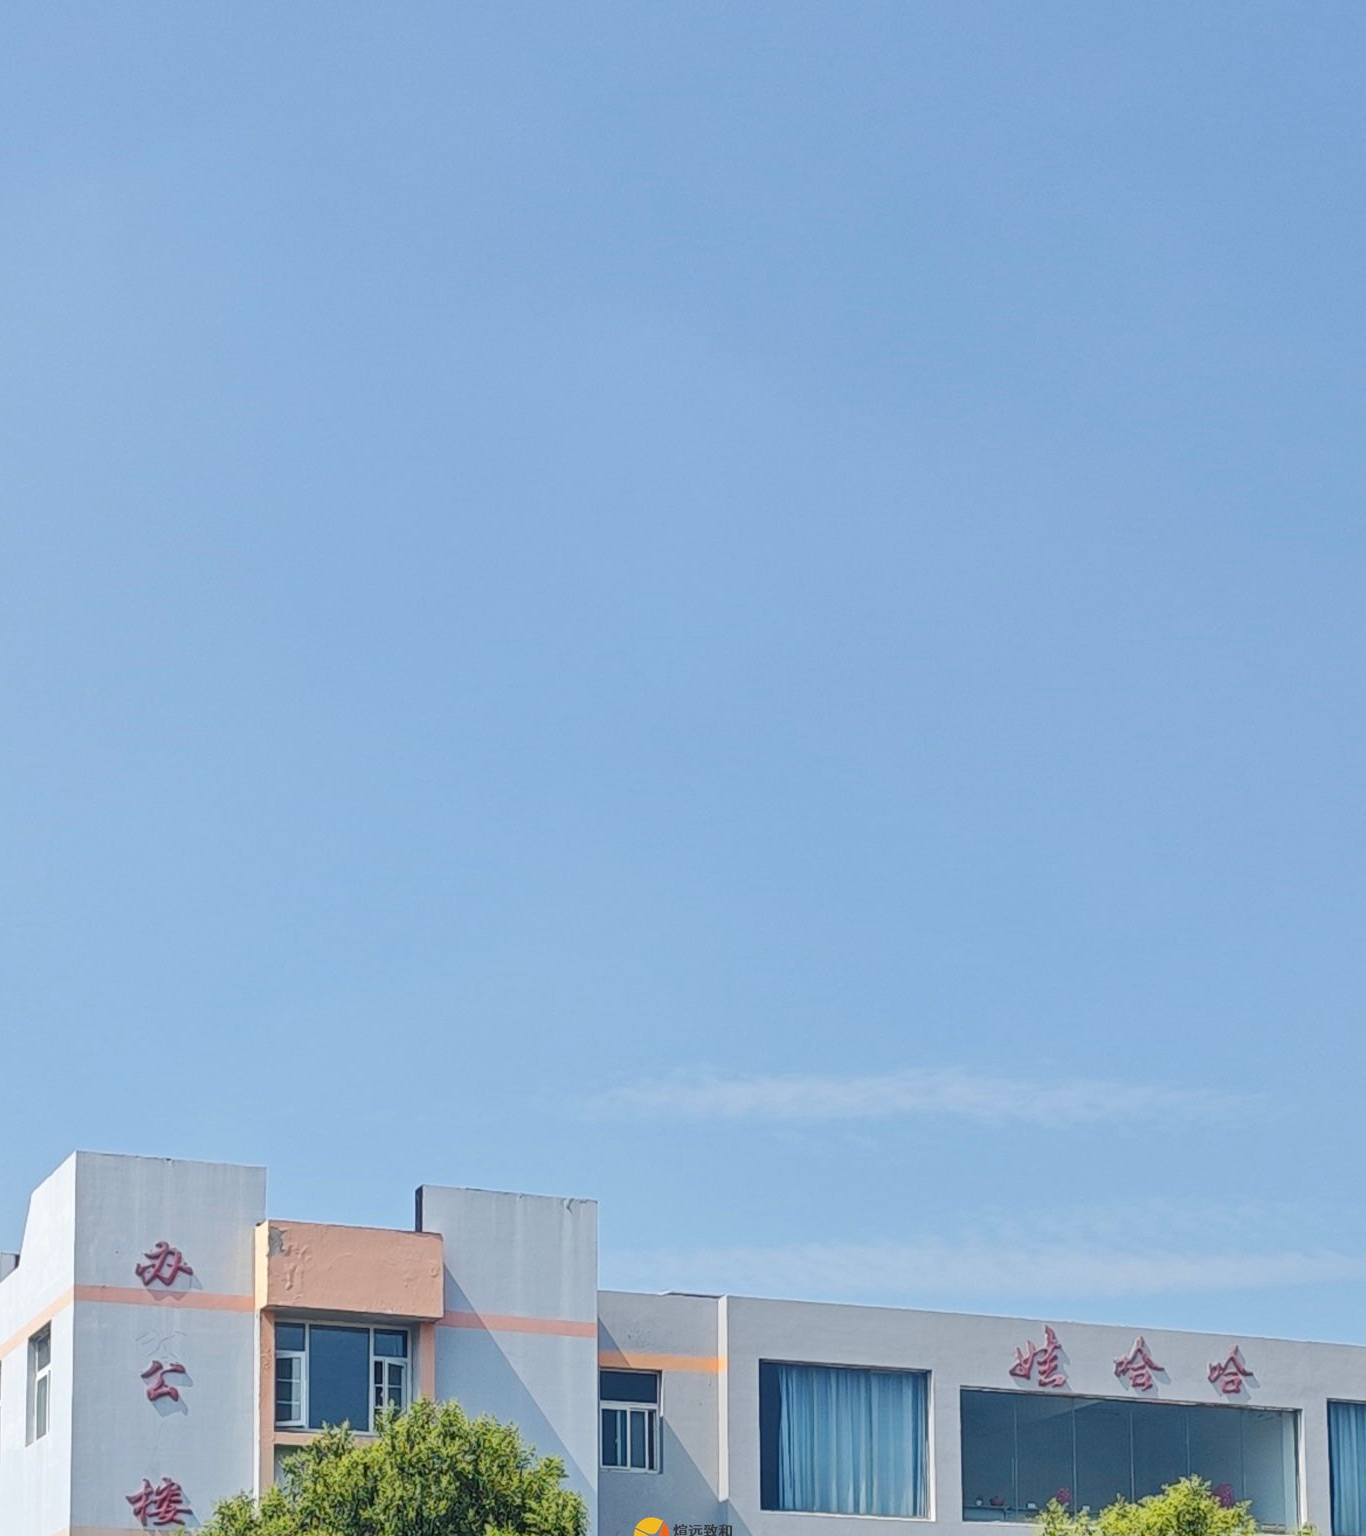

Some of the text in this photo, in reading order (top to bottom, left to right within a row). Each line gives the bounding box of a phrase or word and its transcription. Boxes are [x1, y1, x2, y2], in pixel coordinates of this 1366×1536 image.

[126, 1240, 193, 1527] 办公楼
[1009, 1325, 1253, 1394] 娃哈哈
